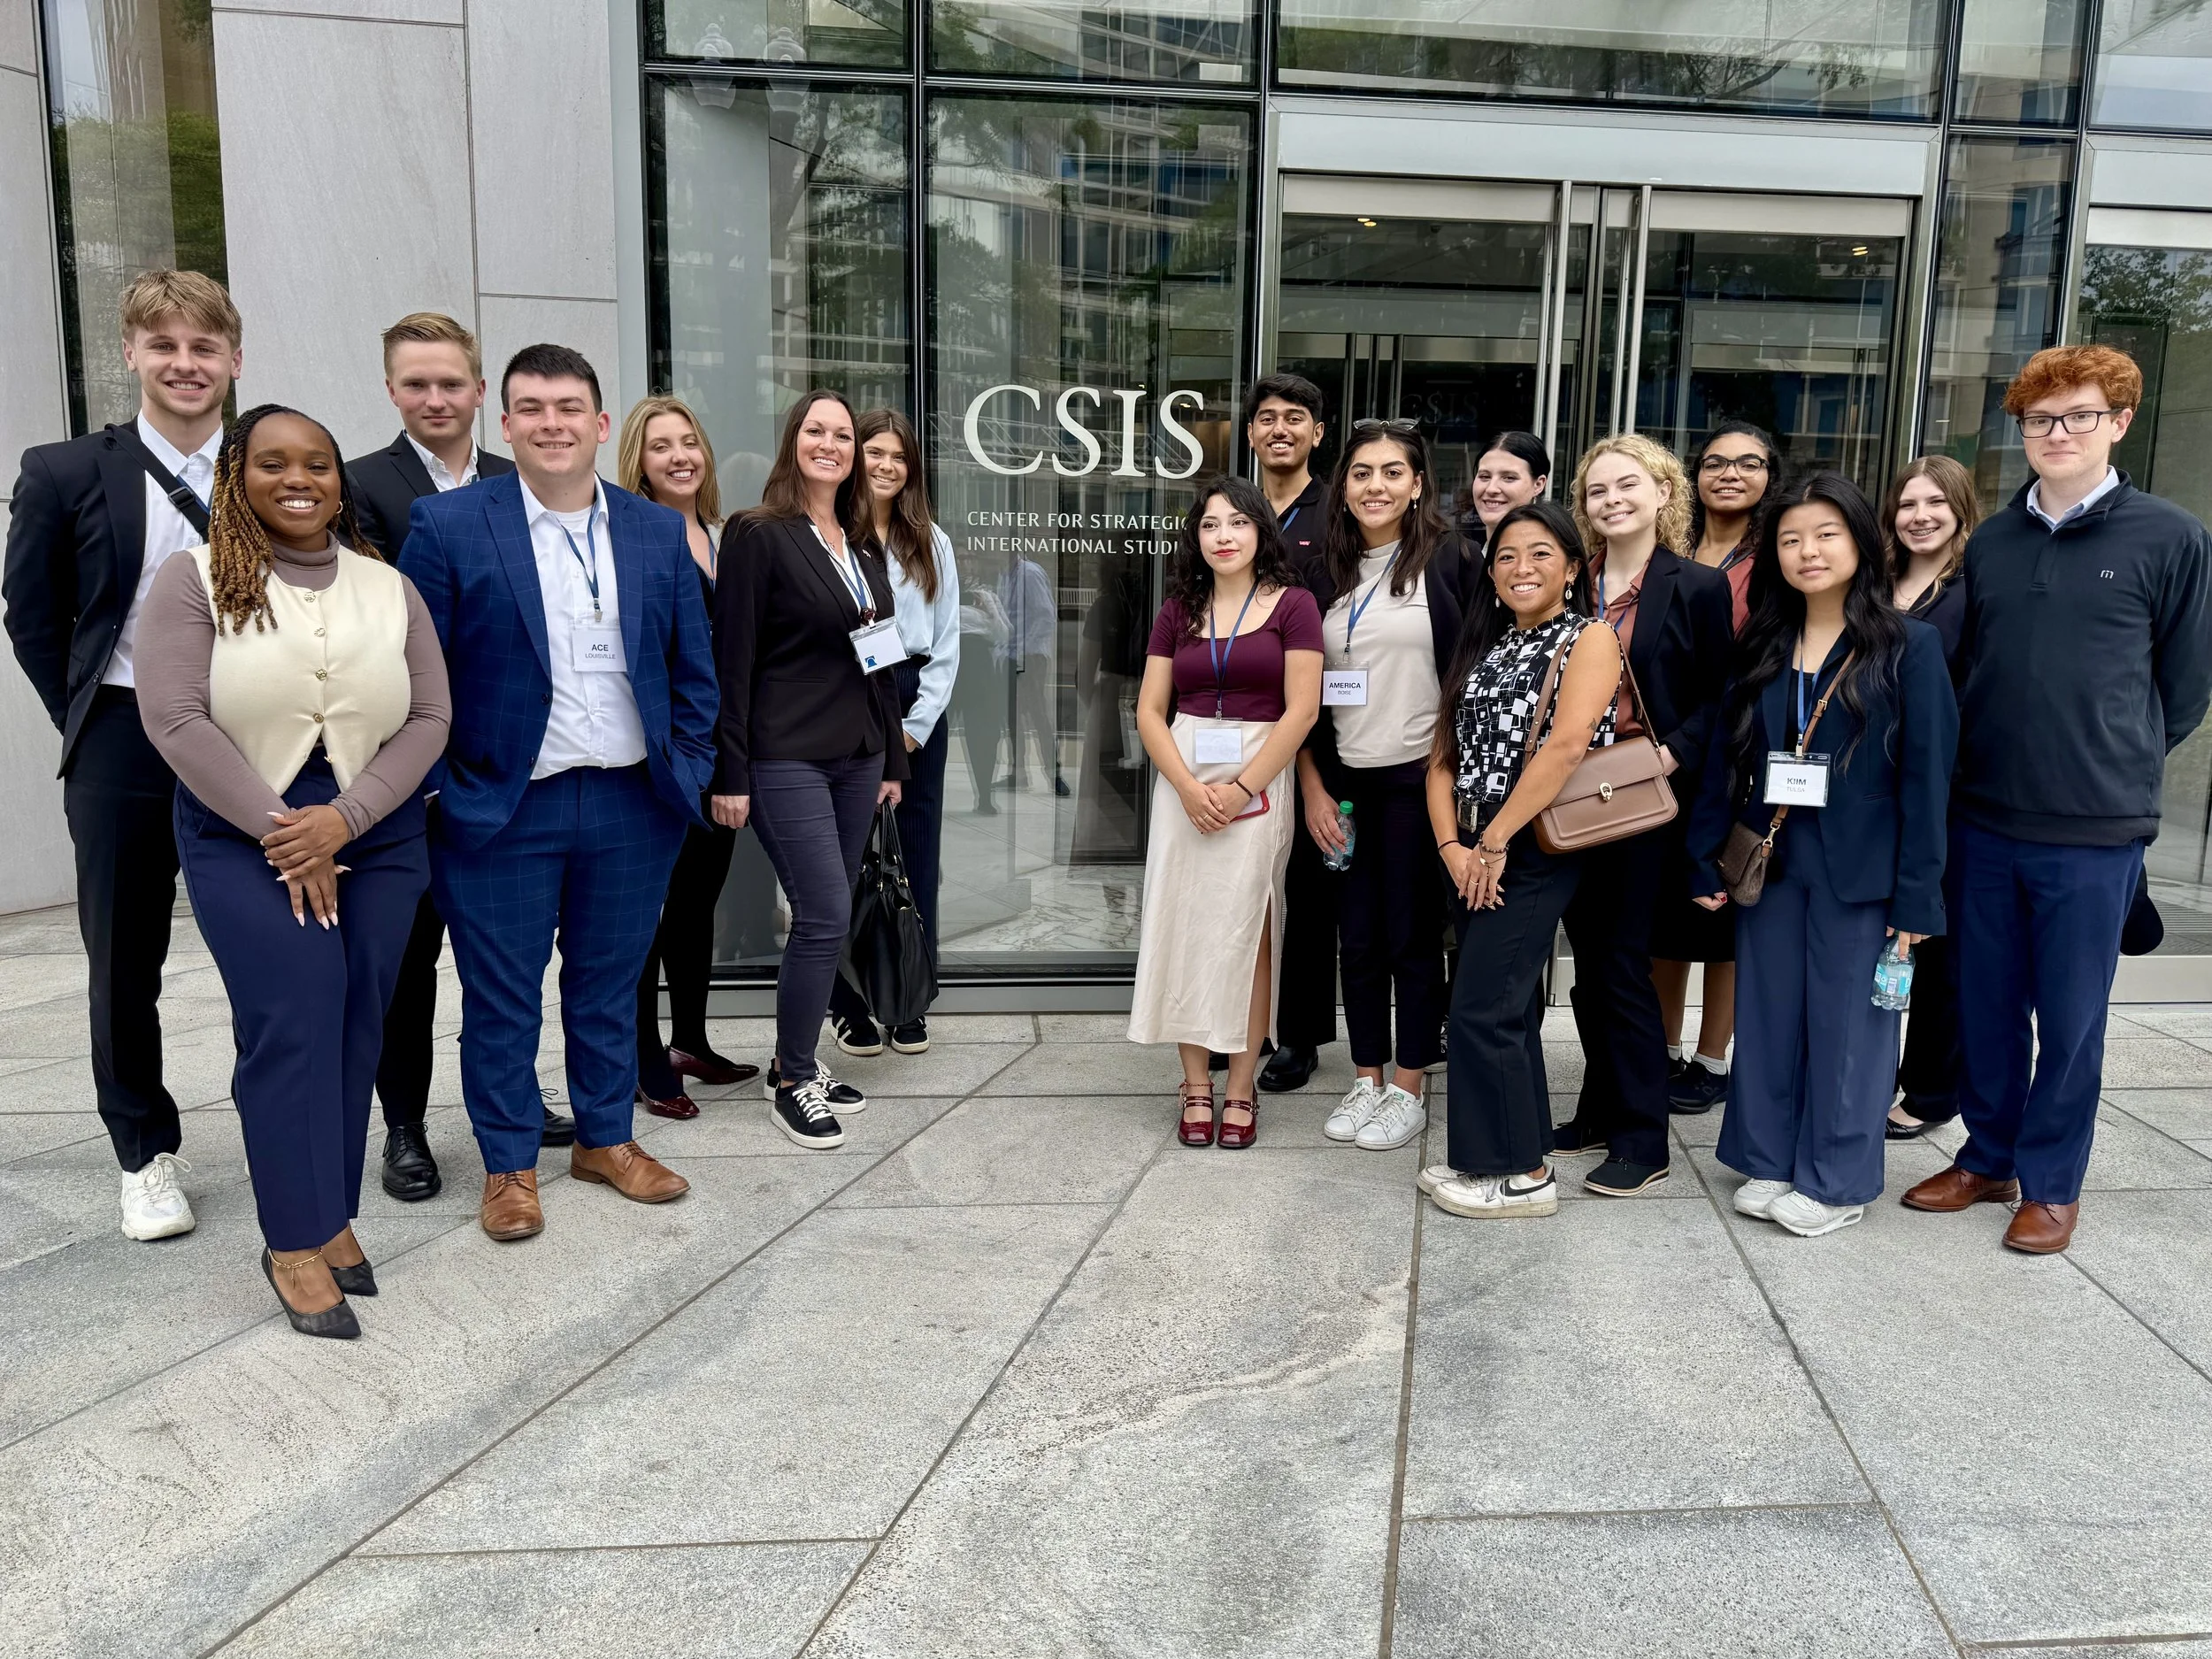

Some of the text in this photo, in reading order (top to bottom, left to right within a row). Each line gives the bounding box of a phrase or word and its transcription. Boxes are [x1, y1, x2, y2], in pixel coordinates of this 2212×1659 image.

[964, 384, 1204, 480] CSIS
[967, 511, 1040, 527] CENTER
[1048, 513, 1083, 528] FOR
[967, 536, 1178, 555] INTERNATIONAL STUDI
